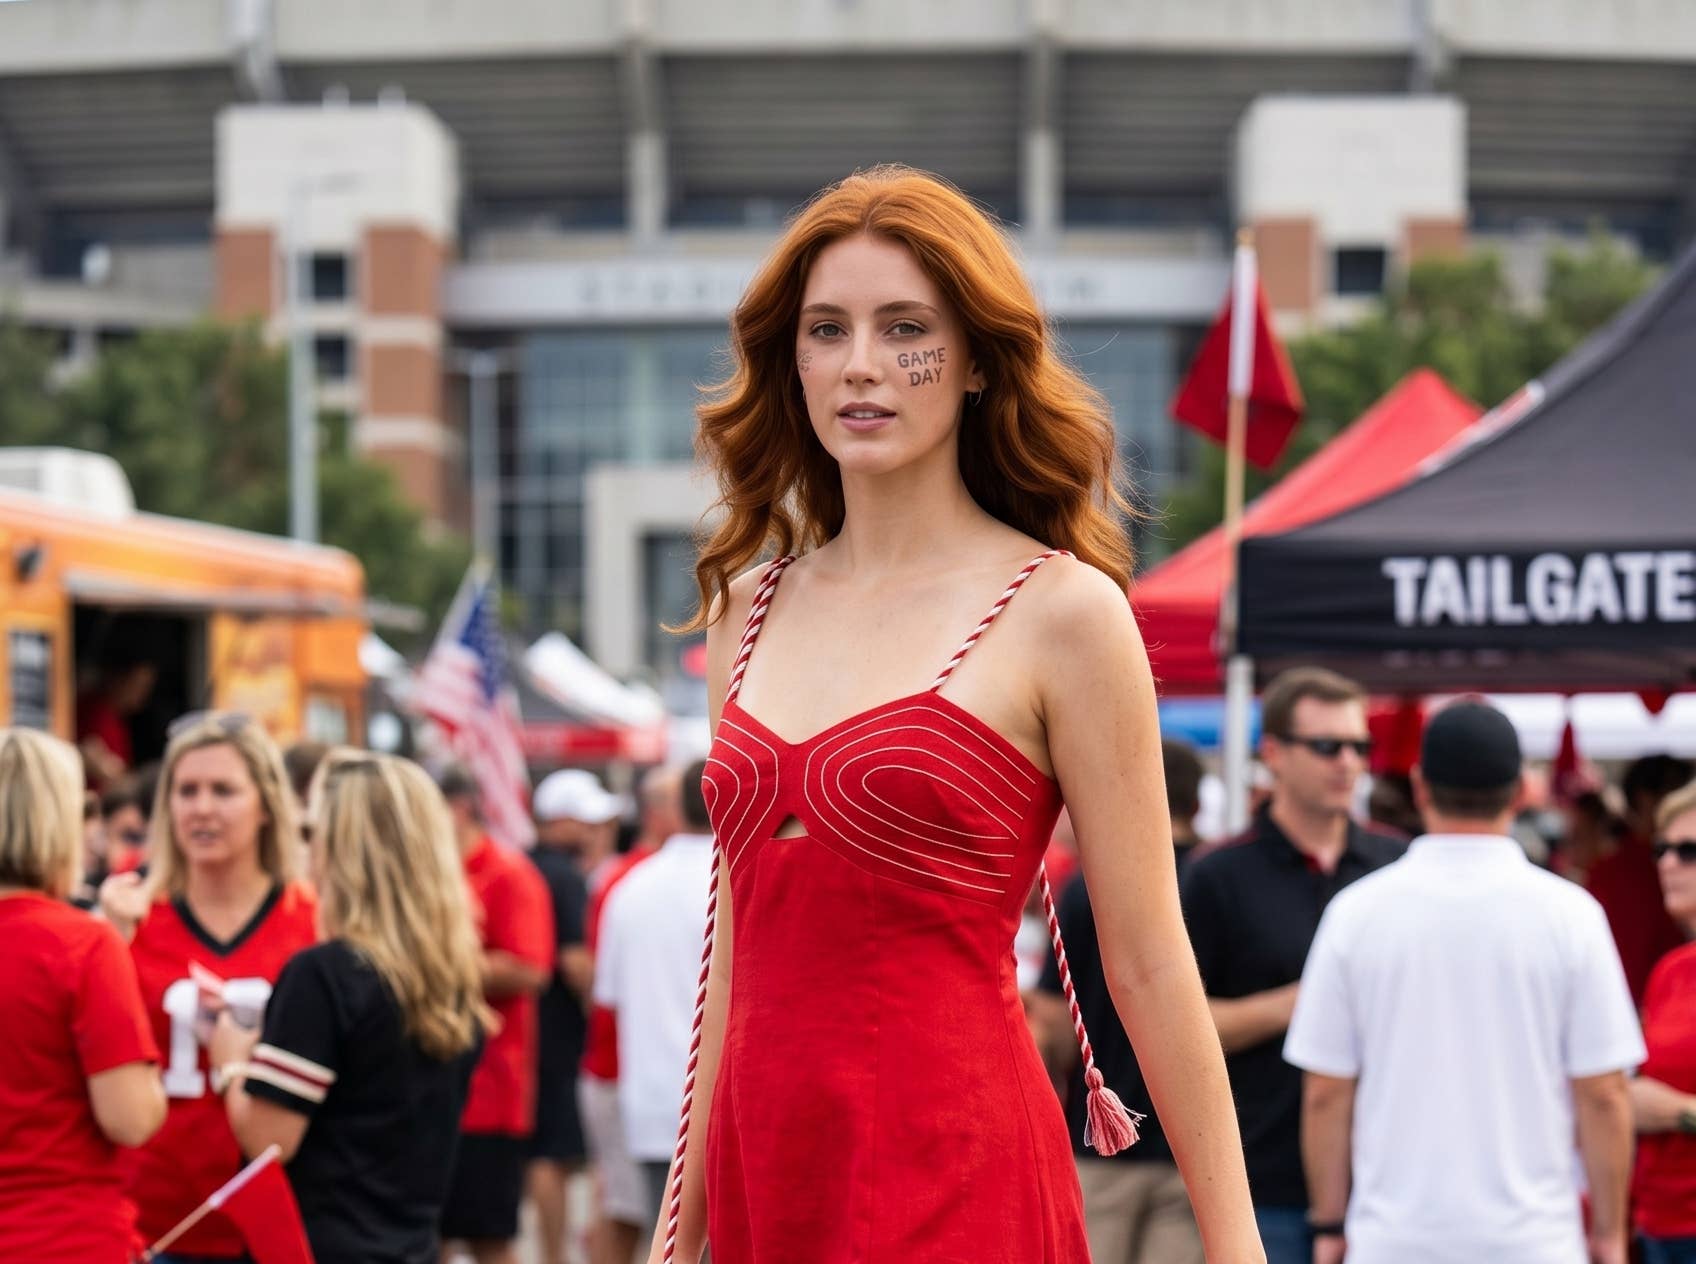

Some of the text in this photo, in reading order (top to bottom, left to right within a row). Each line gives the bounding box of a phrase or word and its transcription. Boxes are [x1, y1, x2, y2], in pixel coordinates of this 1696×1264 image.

[897, 347, 946, 369] GAME
[908, 367, 942, 387] DAY
[1382, 552, 1696, 625] TAILGATE
